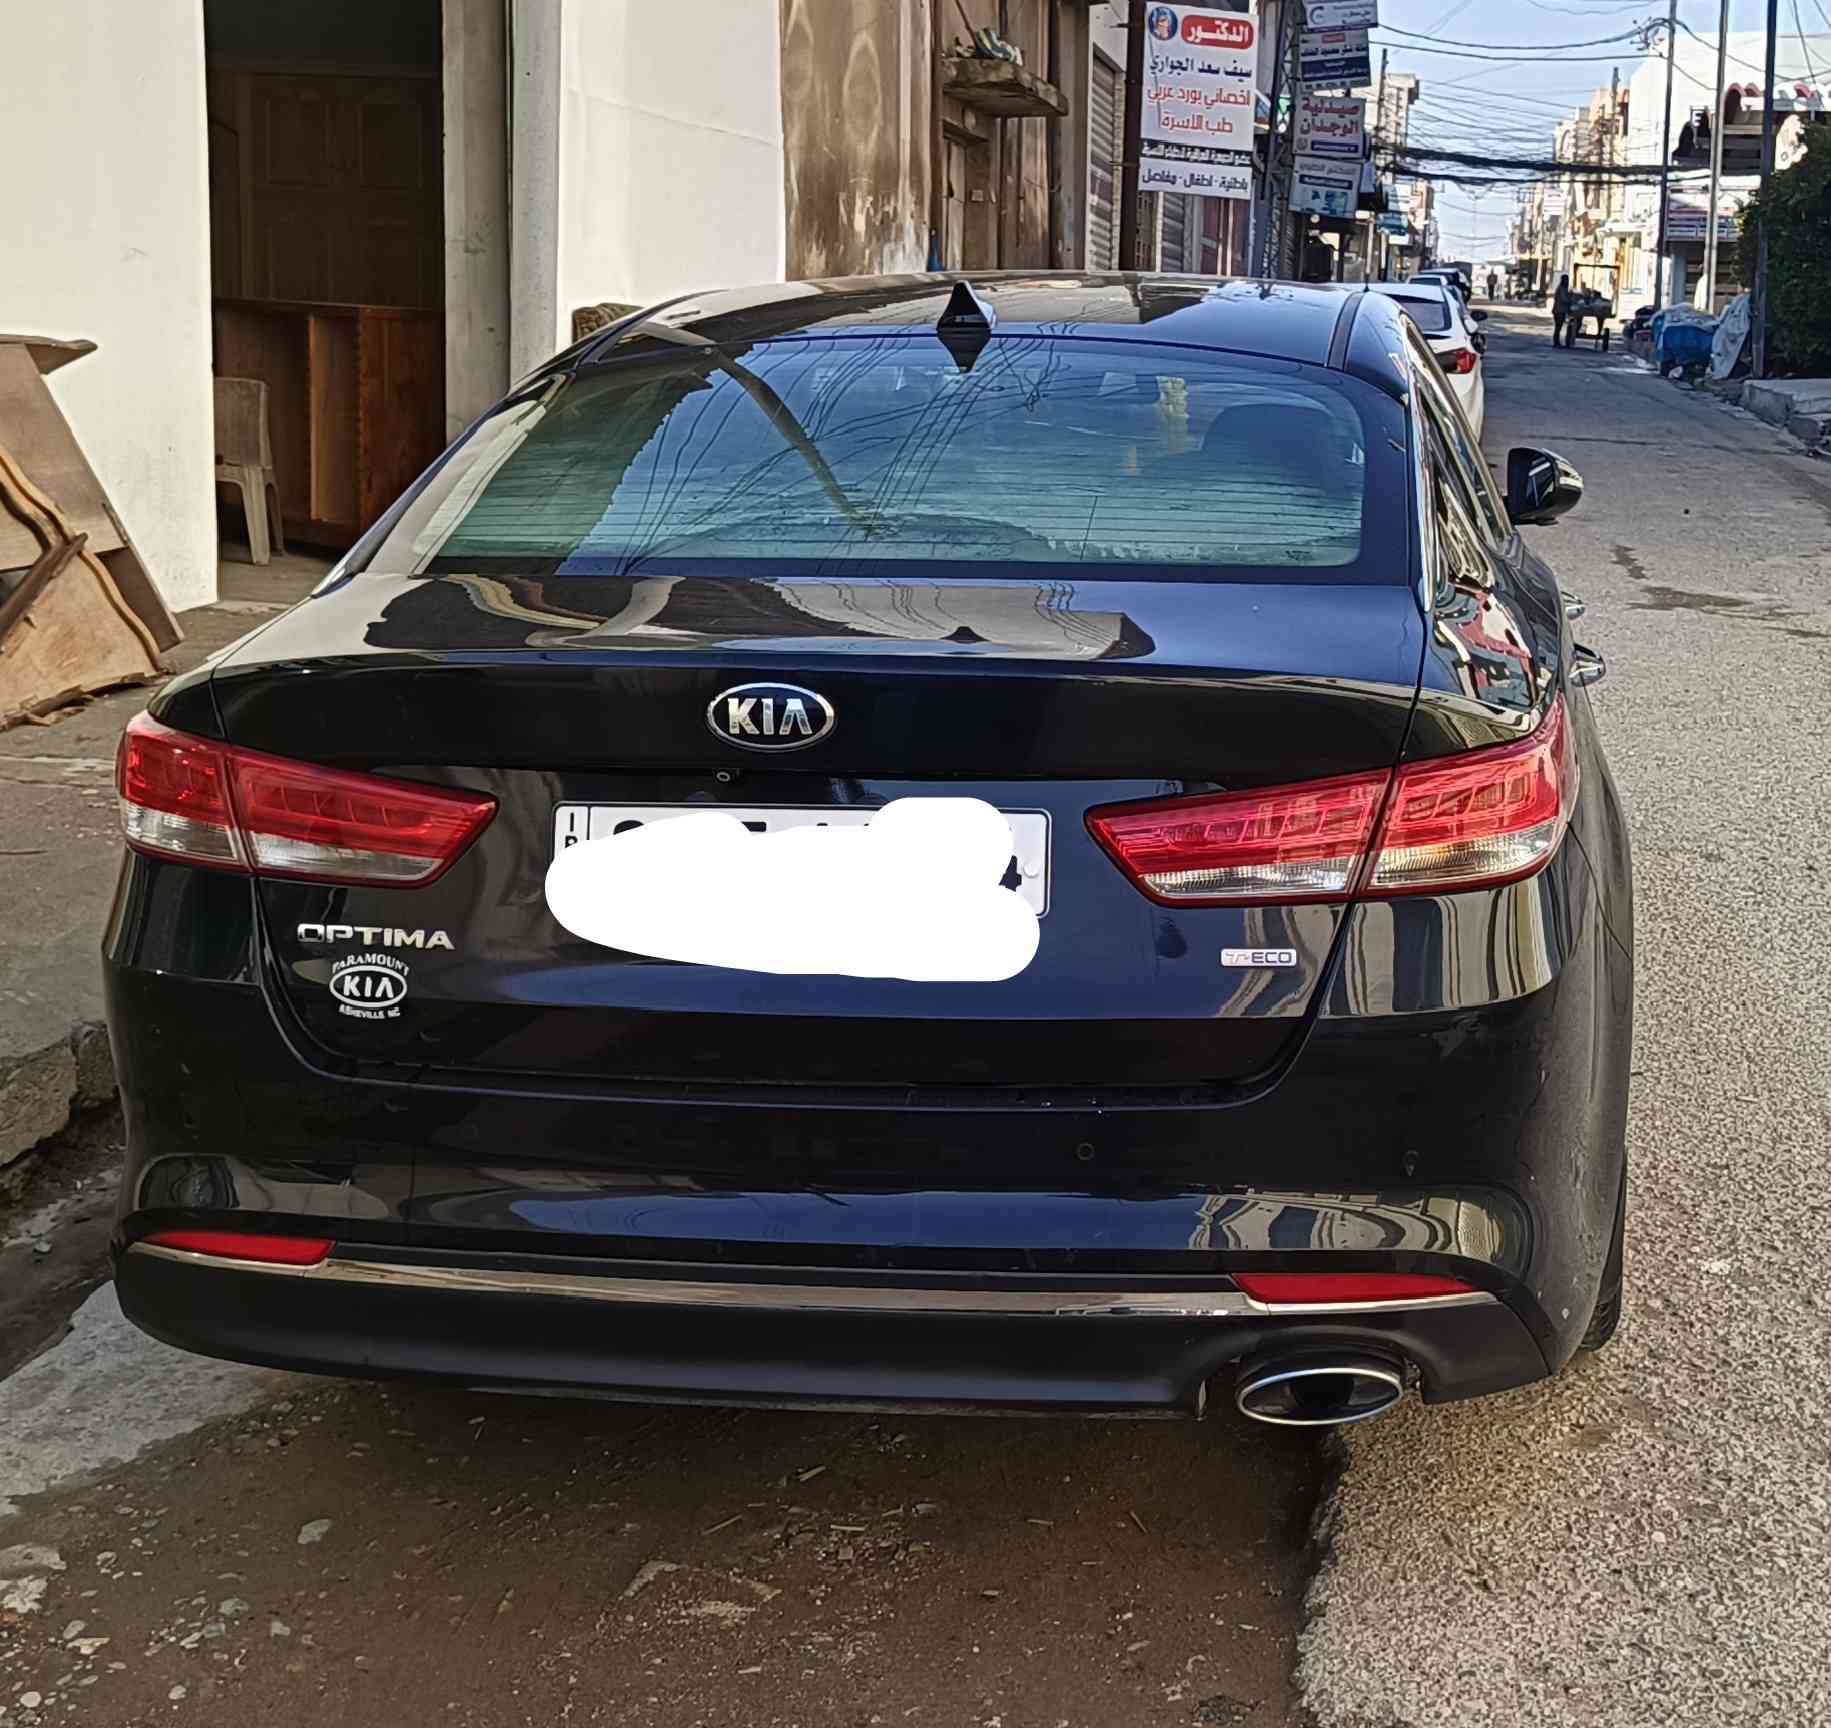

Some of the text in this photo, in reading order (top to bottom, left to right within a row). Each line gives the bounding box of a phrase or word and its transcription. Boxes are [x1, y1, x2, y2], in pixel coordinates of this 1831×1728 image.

[1187, 20, 1249, 43] الدكتور
[1198, 61, 1220, 75] سعد
[1224, 60, 1252, 83] سيف
[1177, 88, 1202, 104] بورد
[1205, 116, 1233, 135] طب
[727, 698, 813, 735] KIA
[297, 923, 456, 950] OPTIMA
[332, 953, 410, 976] PARAMOUNT
[343, 975, 394, 998] KIA
